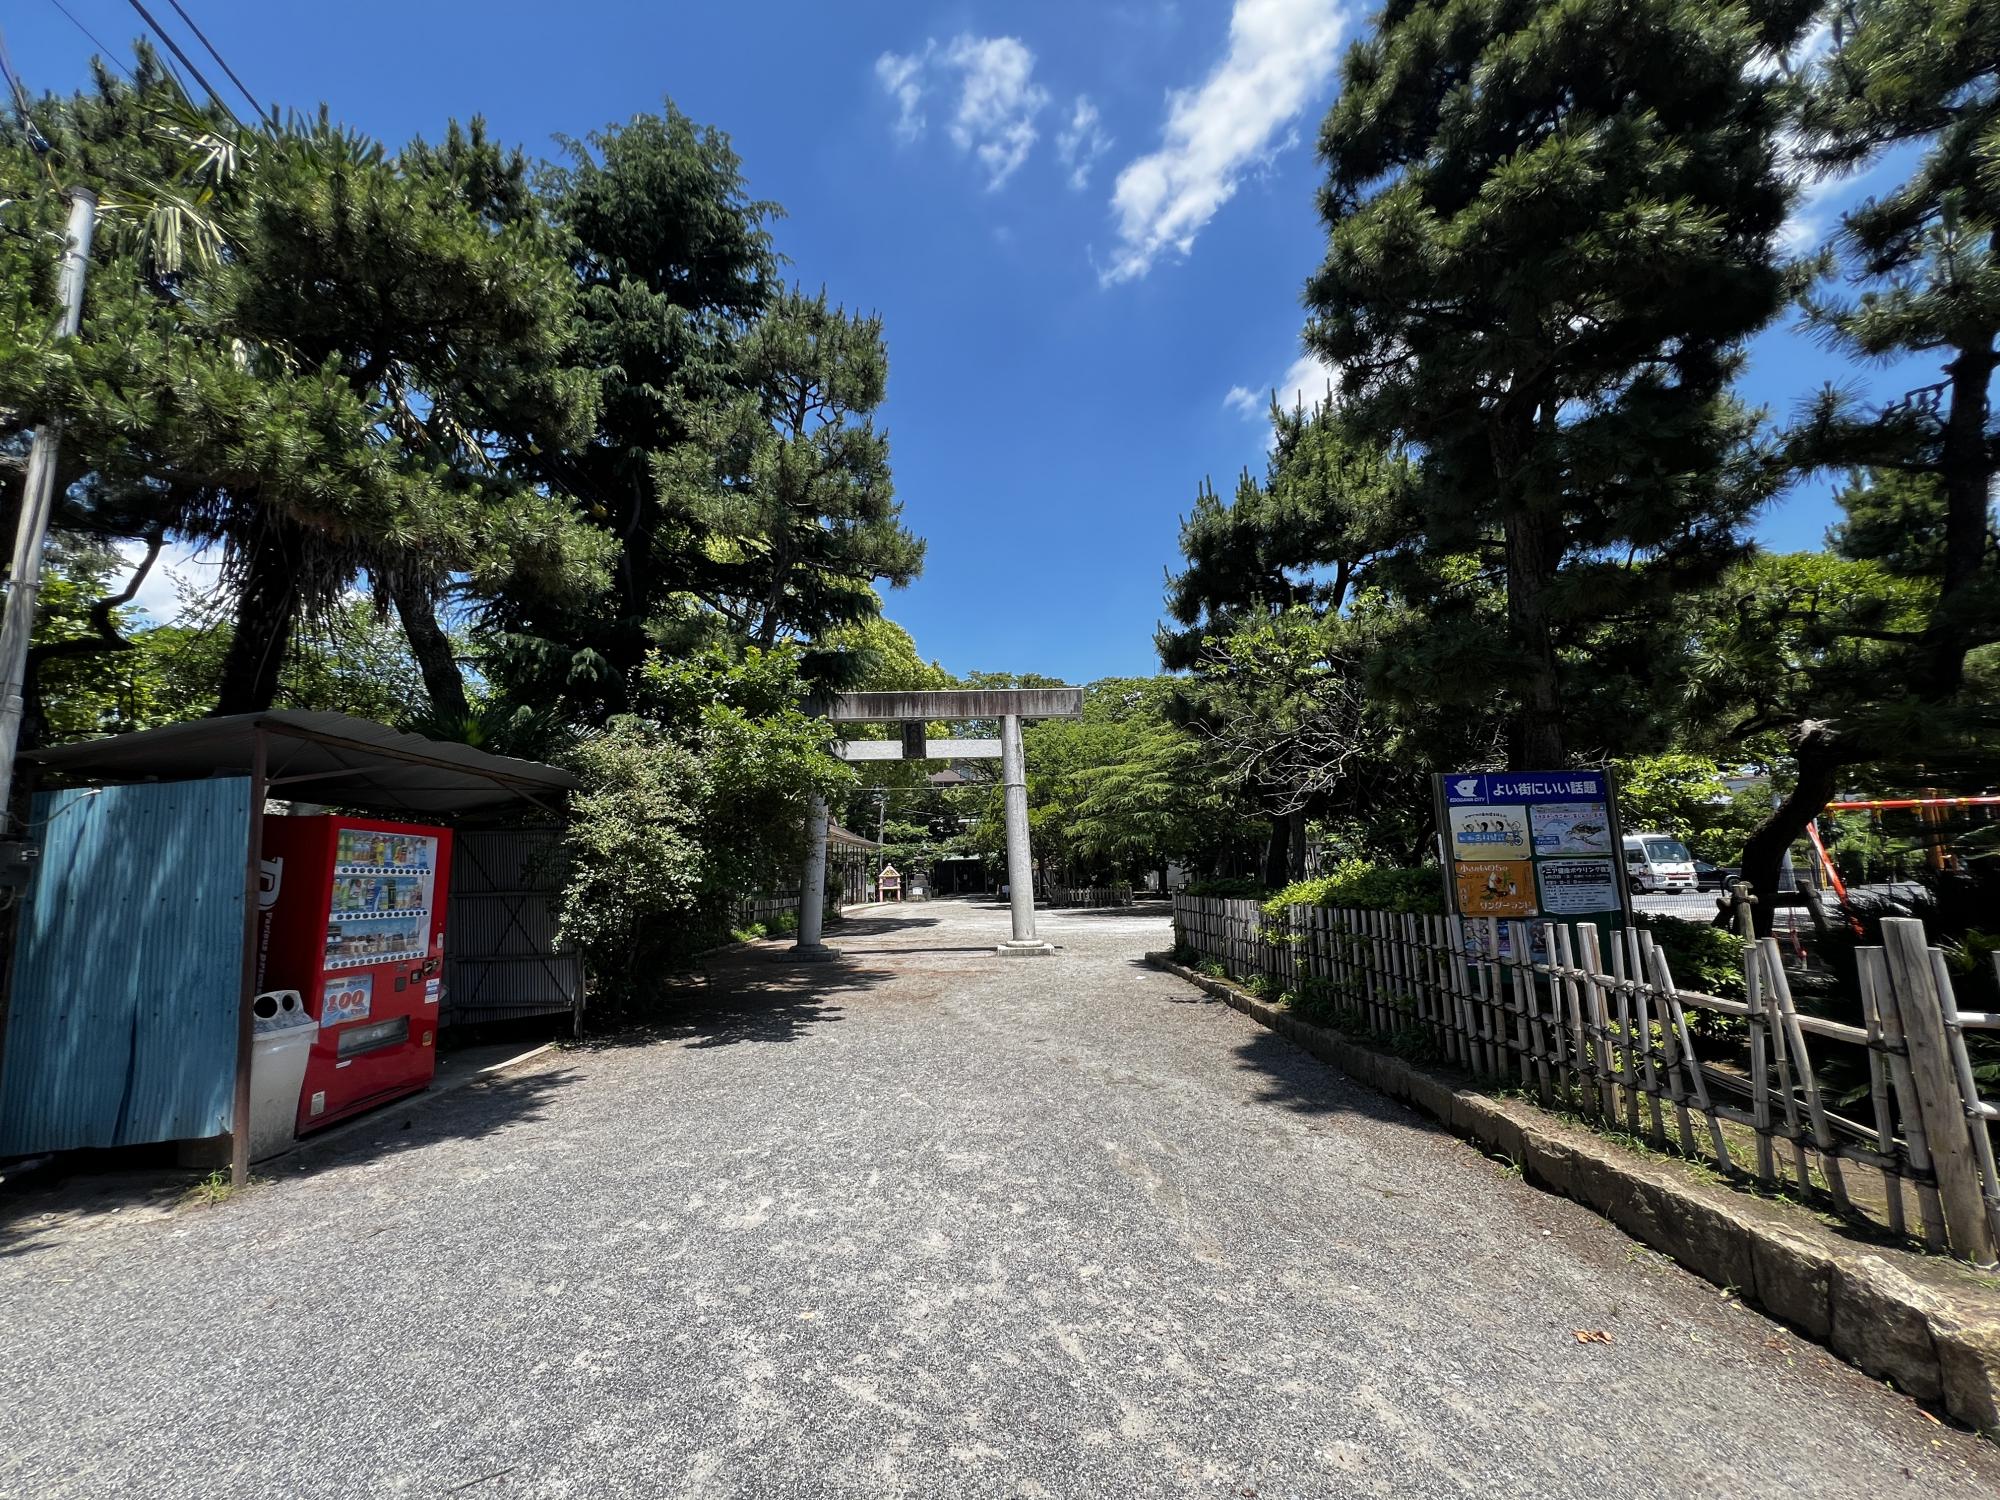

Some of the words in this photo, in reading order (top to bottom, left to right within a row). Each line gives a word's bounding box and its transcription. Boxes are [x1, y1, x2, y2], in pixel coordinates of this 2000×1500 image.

[1493, 781, 1598, 796] よい街にいい話題
[327, 989, 365, 1011] 100
